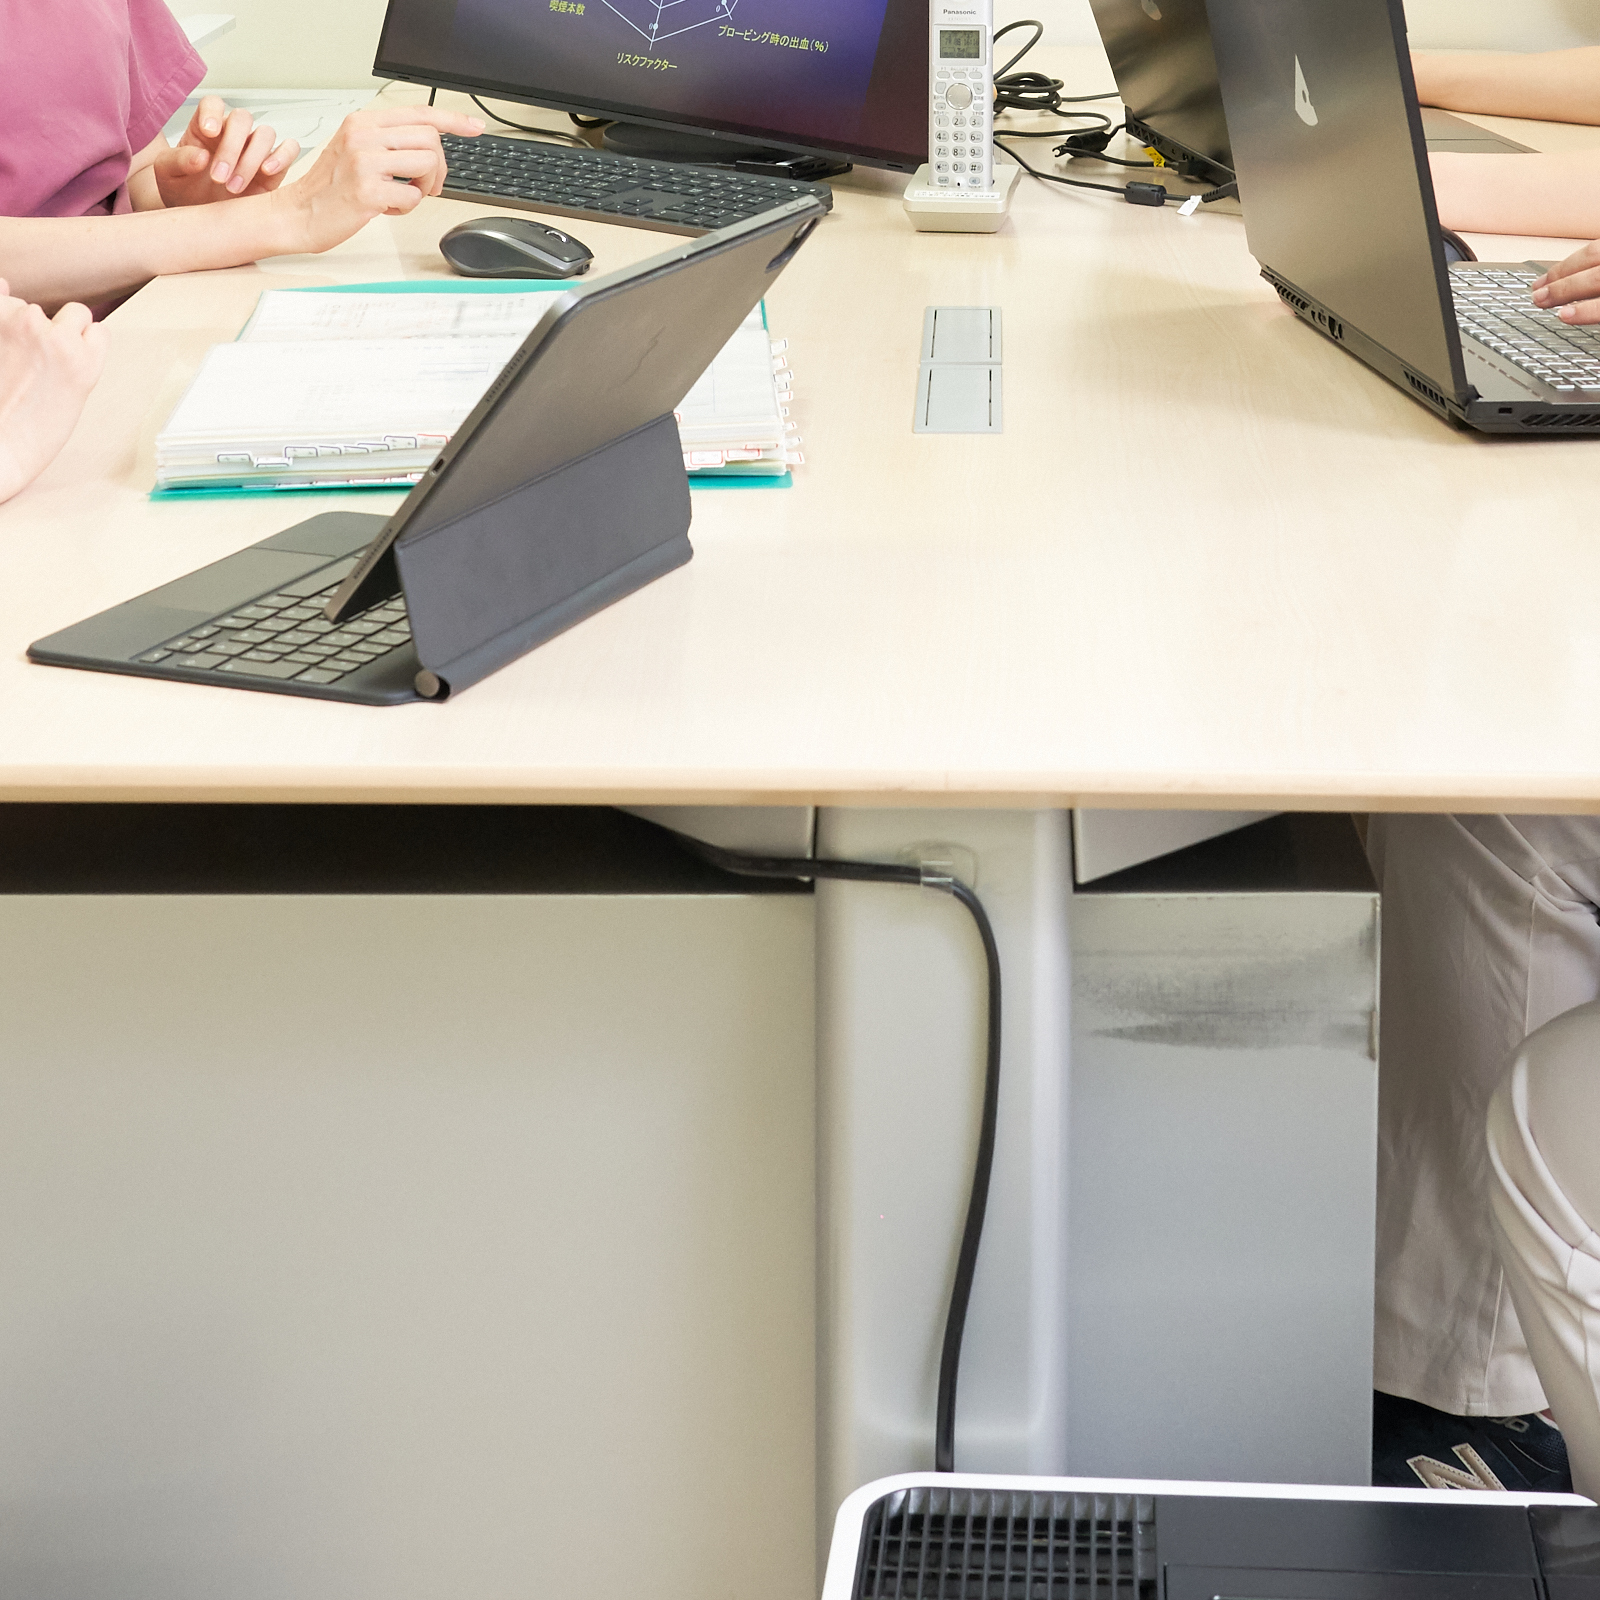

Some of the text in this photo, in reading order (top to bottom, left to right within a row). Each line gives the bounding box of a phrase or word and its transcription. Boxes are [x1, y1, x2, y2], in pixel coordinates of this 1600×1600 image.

[549, 0, 585, 16] 喫煙本数
[617, 52, 677, 71] リスクファクター
[1406, 1442, 1508, 1491] N
